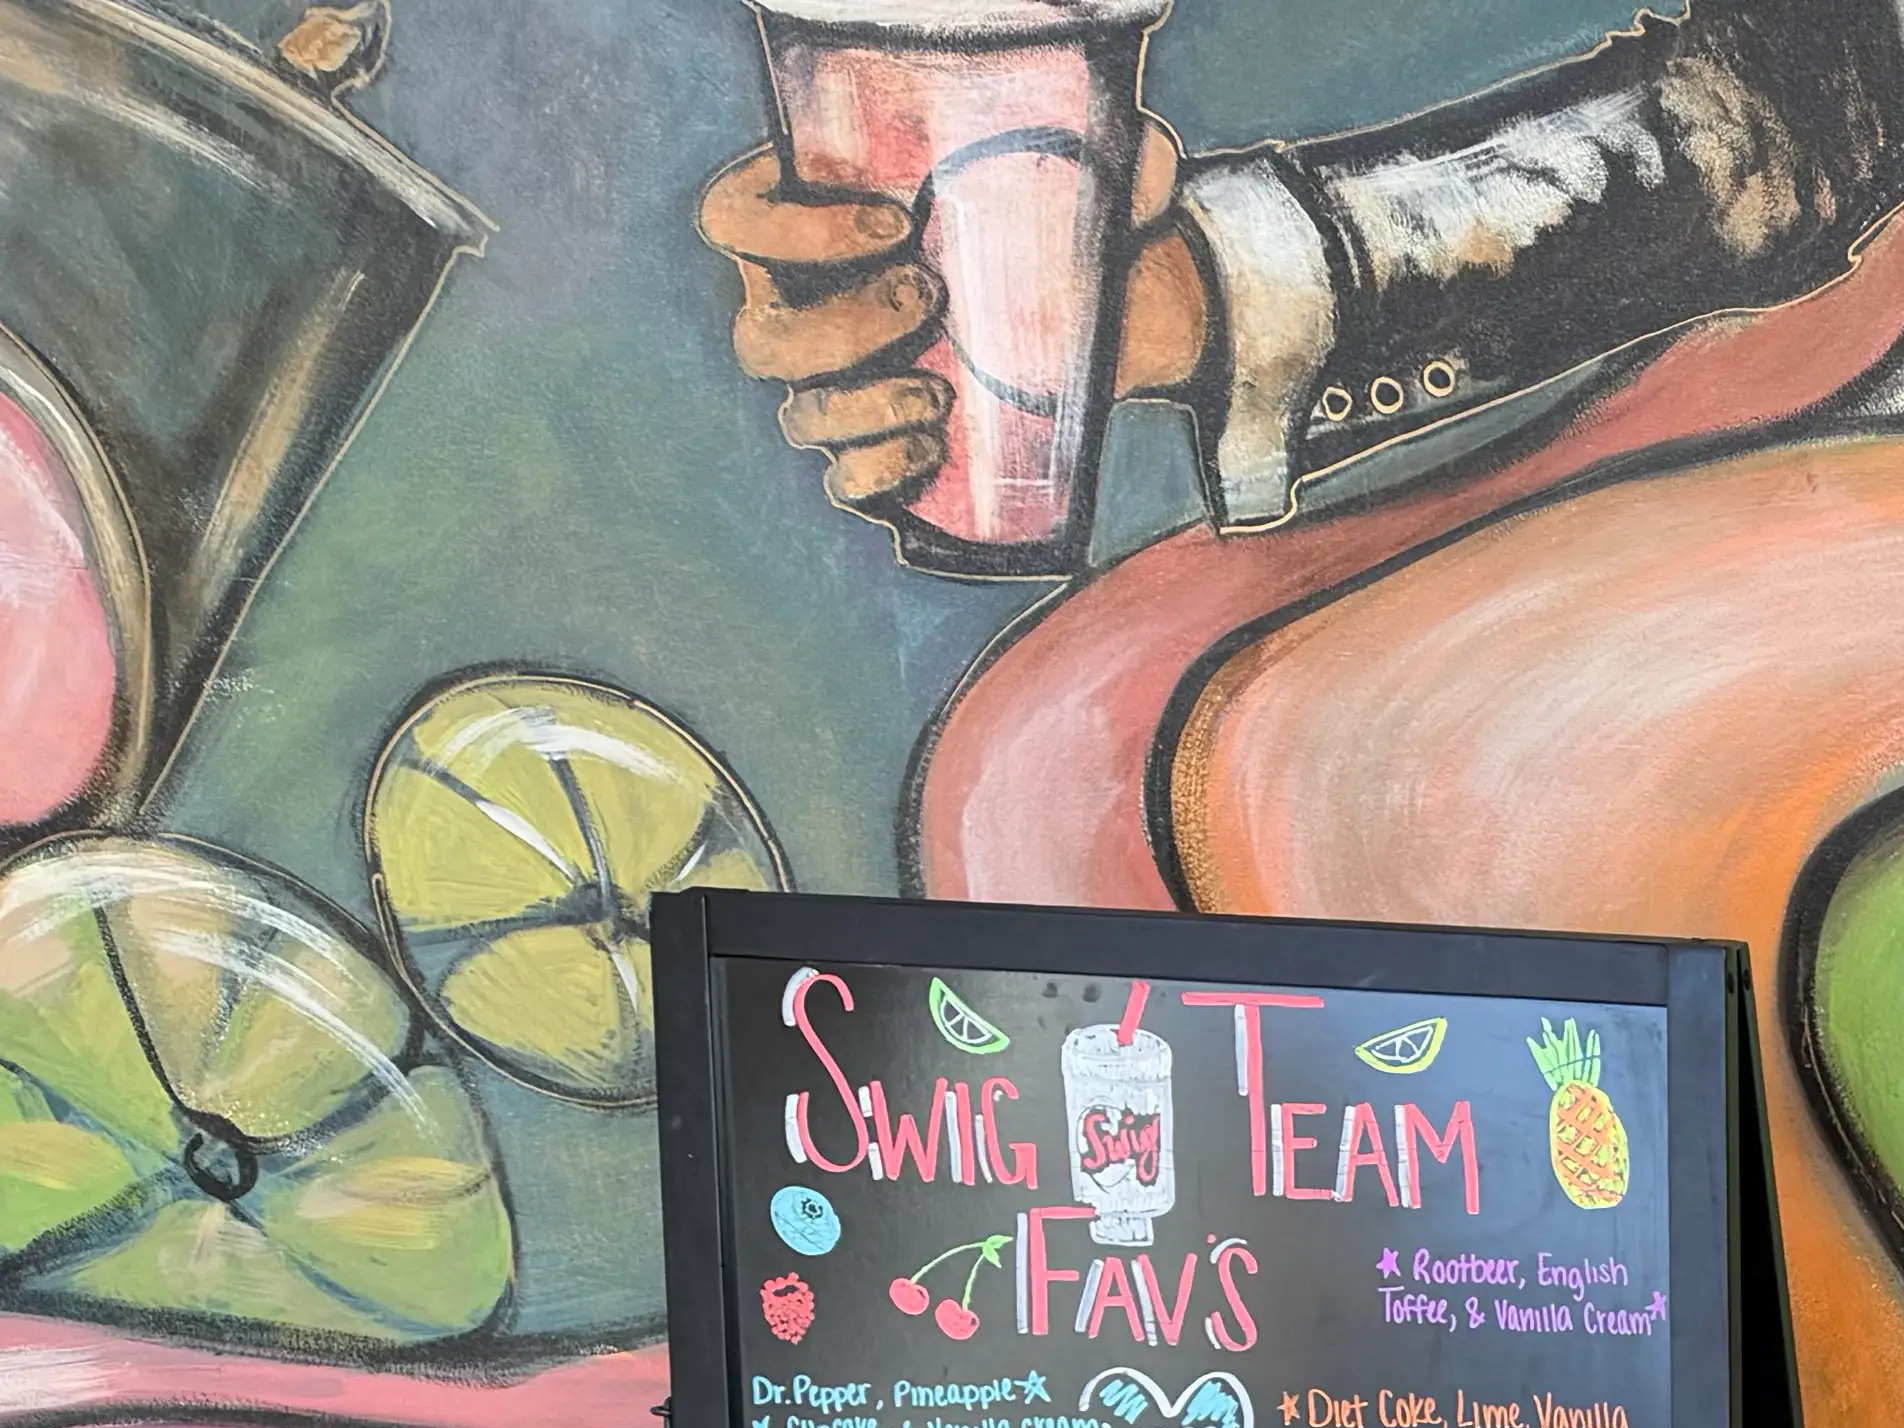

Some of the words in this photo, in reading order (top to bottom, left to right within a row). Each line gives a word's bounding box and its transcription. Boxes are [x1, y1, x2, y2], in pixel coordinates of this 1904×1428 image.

[782, 967, 1037, 1189] SWIG
[1181, 991, 1480, 1216] TEAM
[1413, 1248, 1526, 1290] Rootbeer,
[1537, 1252, 1628, 1301] English
[1378, 1286, 1457, 1332] Toffee,
[1466, 1304, 1486, 1329] &
[1496, 1300, 1573, 1332] Vanilla
[1584, 1304, 1651, 1336] Cream
